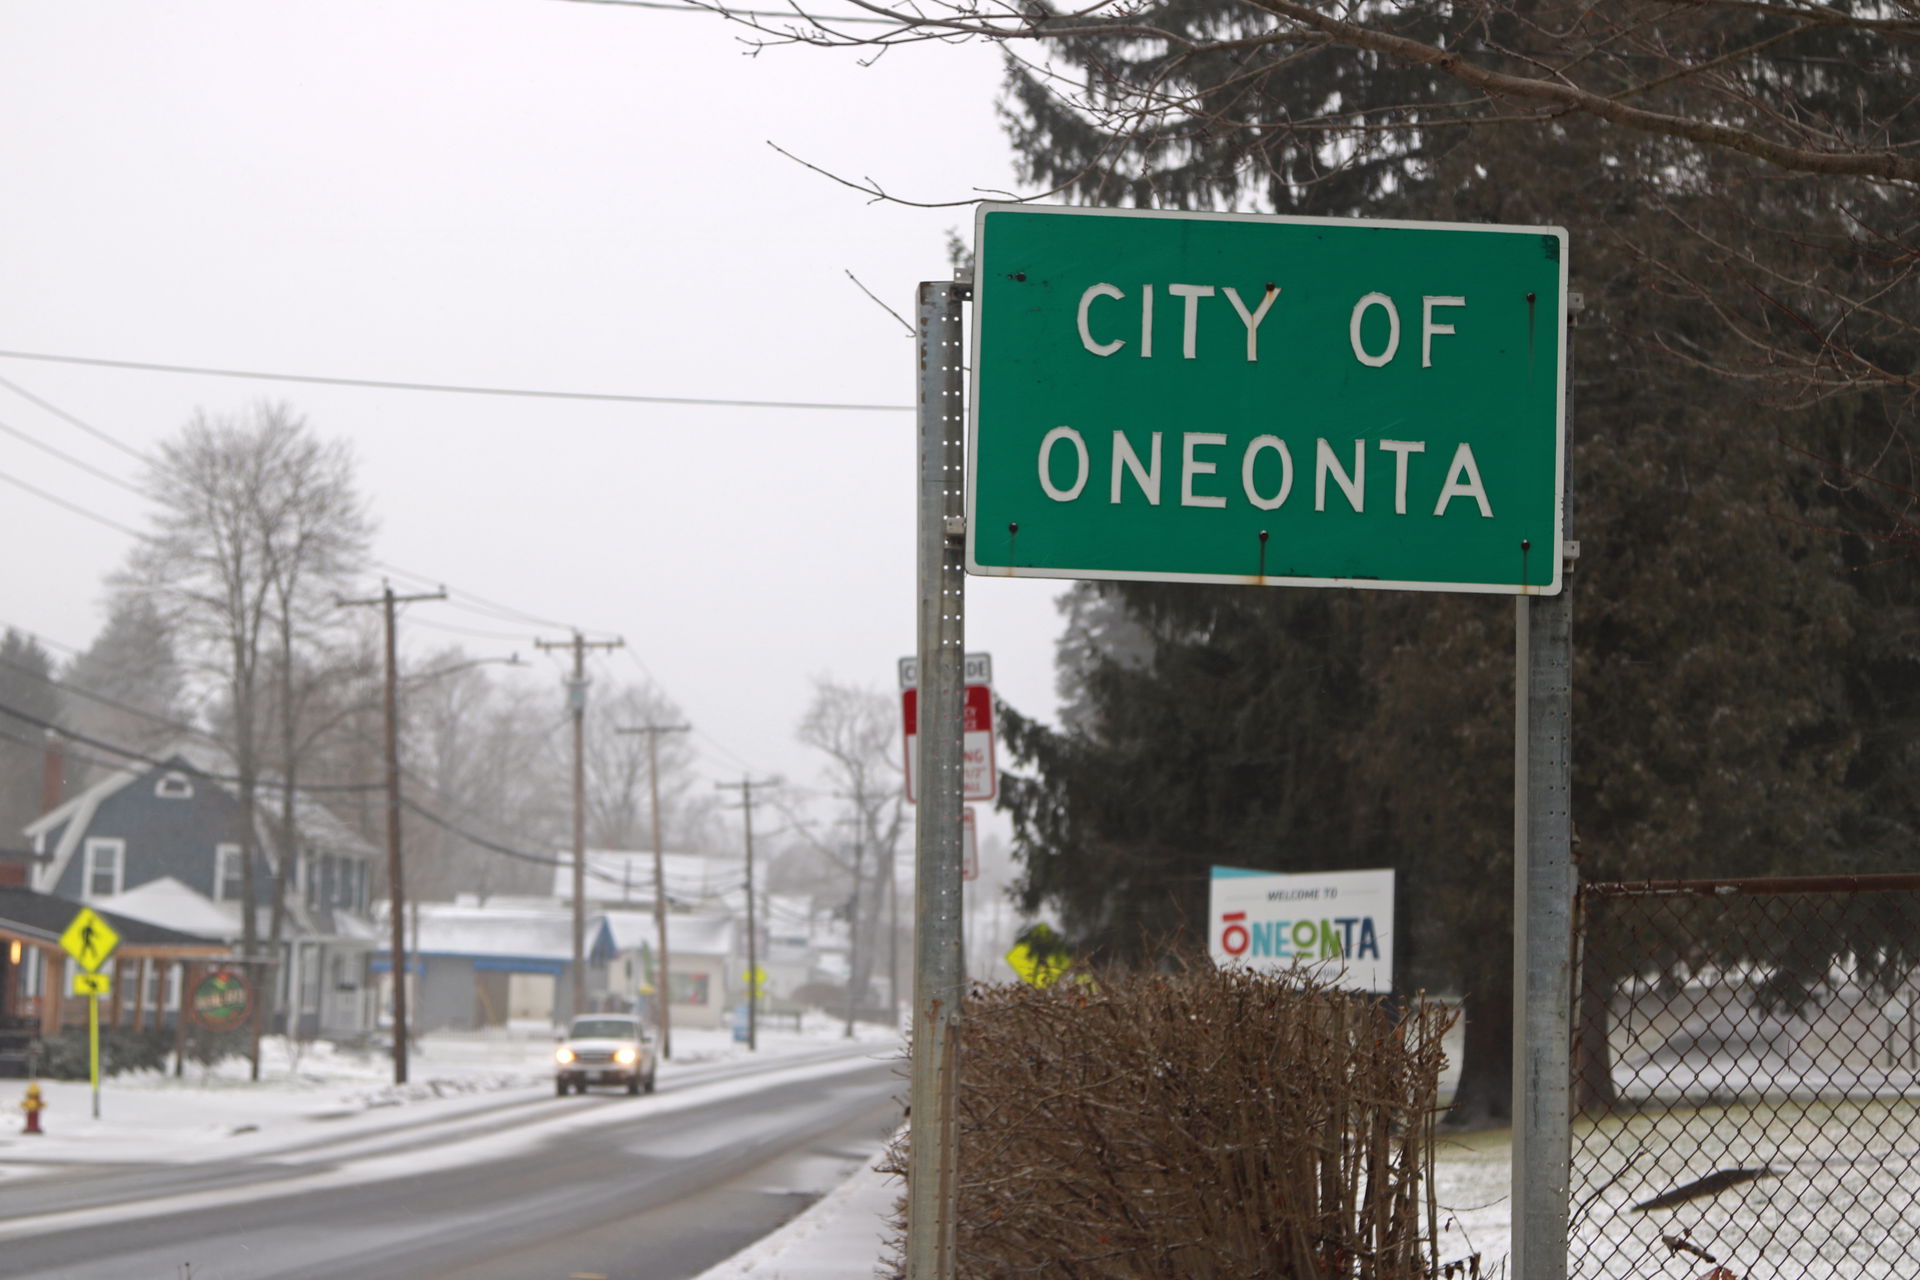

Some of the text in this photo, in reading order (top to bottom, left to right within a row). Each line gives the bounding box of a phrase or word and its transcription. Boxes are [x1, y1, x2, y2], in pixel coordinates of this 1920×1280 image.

[1077, 282, 1466, 368] CITY OF
[1038, 425, 1494, 518] ONEONTA
[1267, 887, 1338, 902] WELCOME TO
